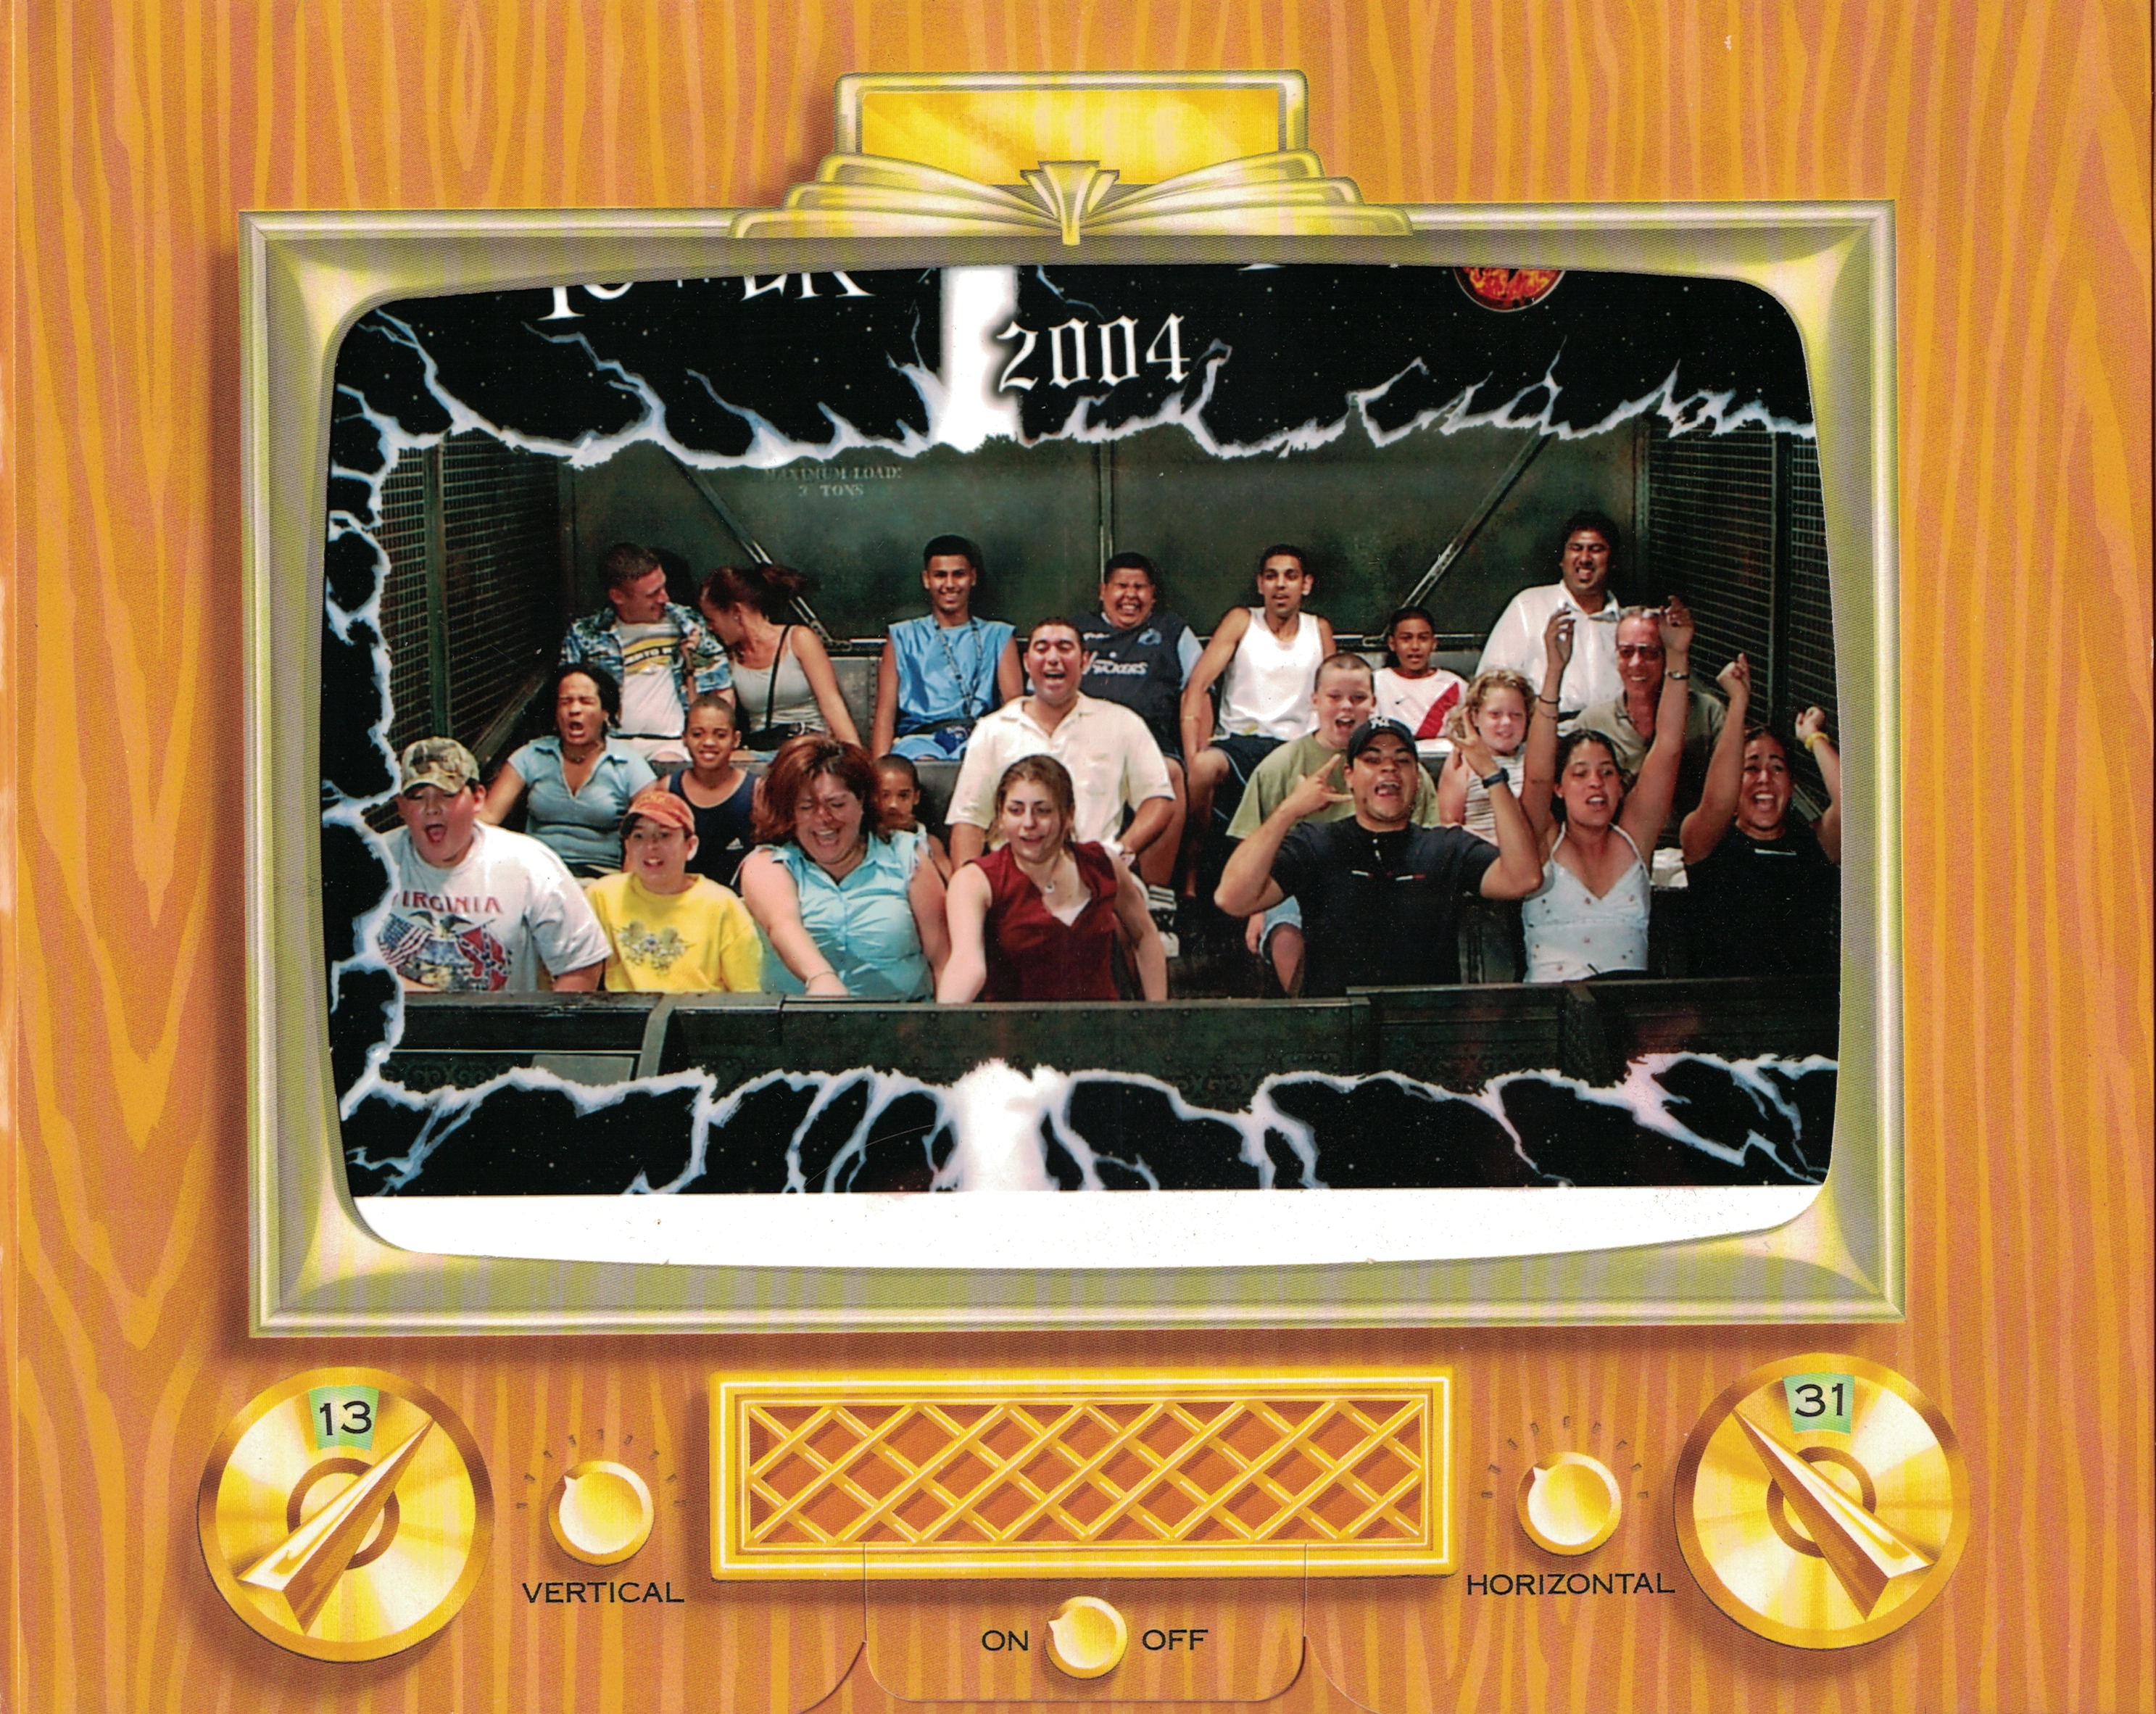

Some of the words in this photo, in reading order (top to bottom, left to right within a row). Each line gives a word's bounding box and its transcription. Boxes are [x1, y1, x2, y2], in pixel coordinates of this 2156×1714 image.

[997, 312, 1190, 393] 2004
[818, 484, 864, 497] TONS
[1794, 1383, 1845, 1418] 31
[318, 1400, 373, 1436] 13
[522, 1581, 686, 1604] VERTICAL
[1466, 1572, 1677, 1597] HORIZONTAL
[981, 1629, 1029, 1652] ON
[1141, 1628, 1209, 1652] OFF
